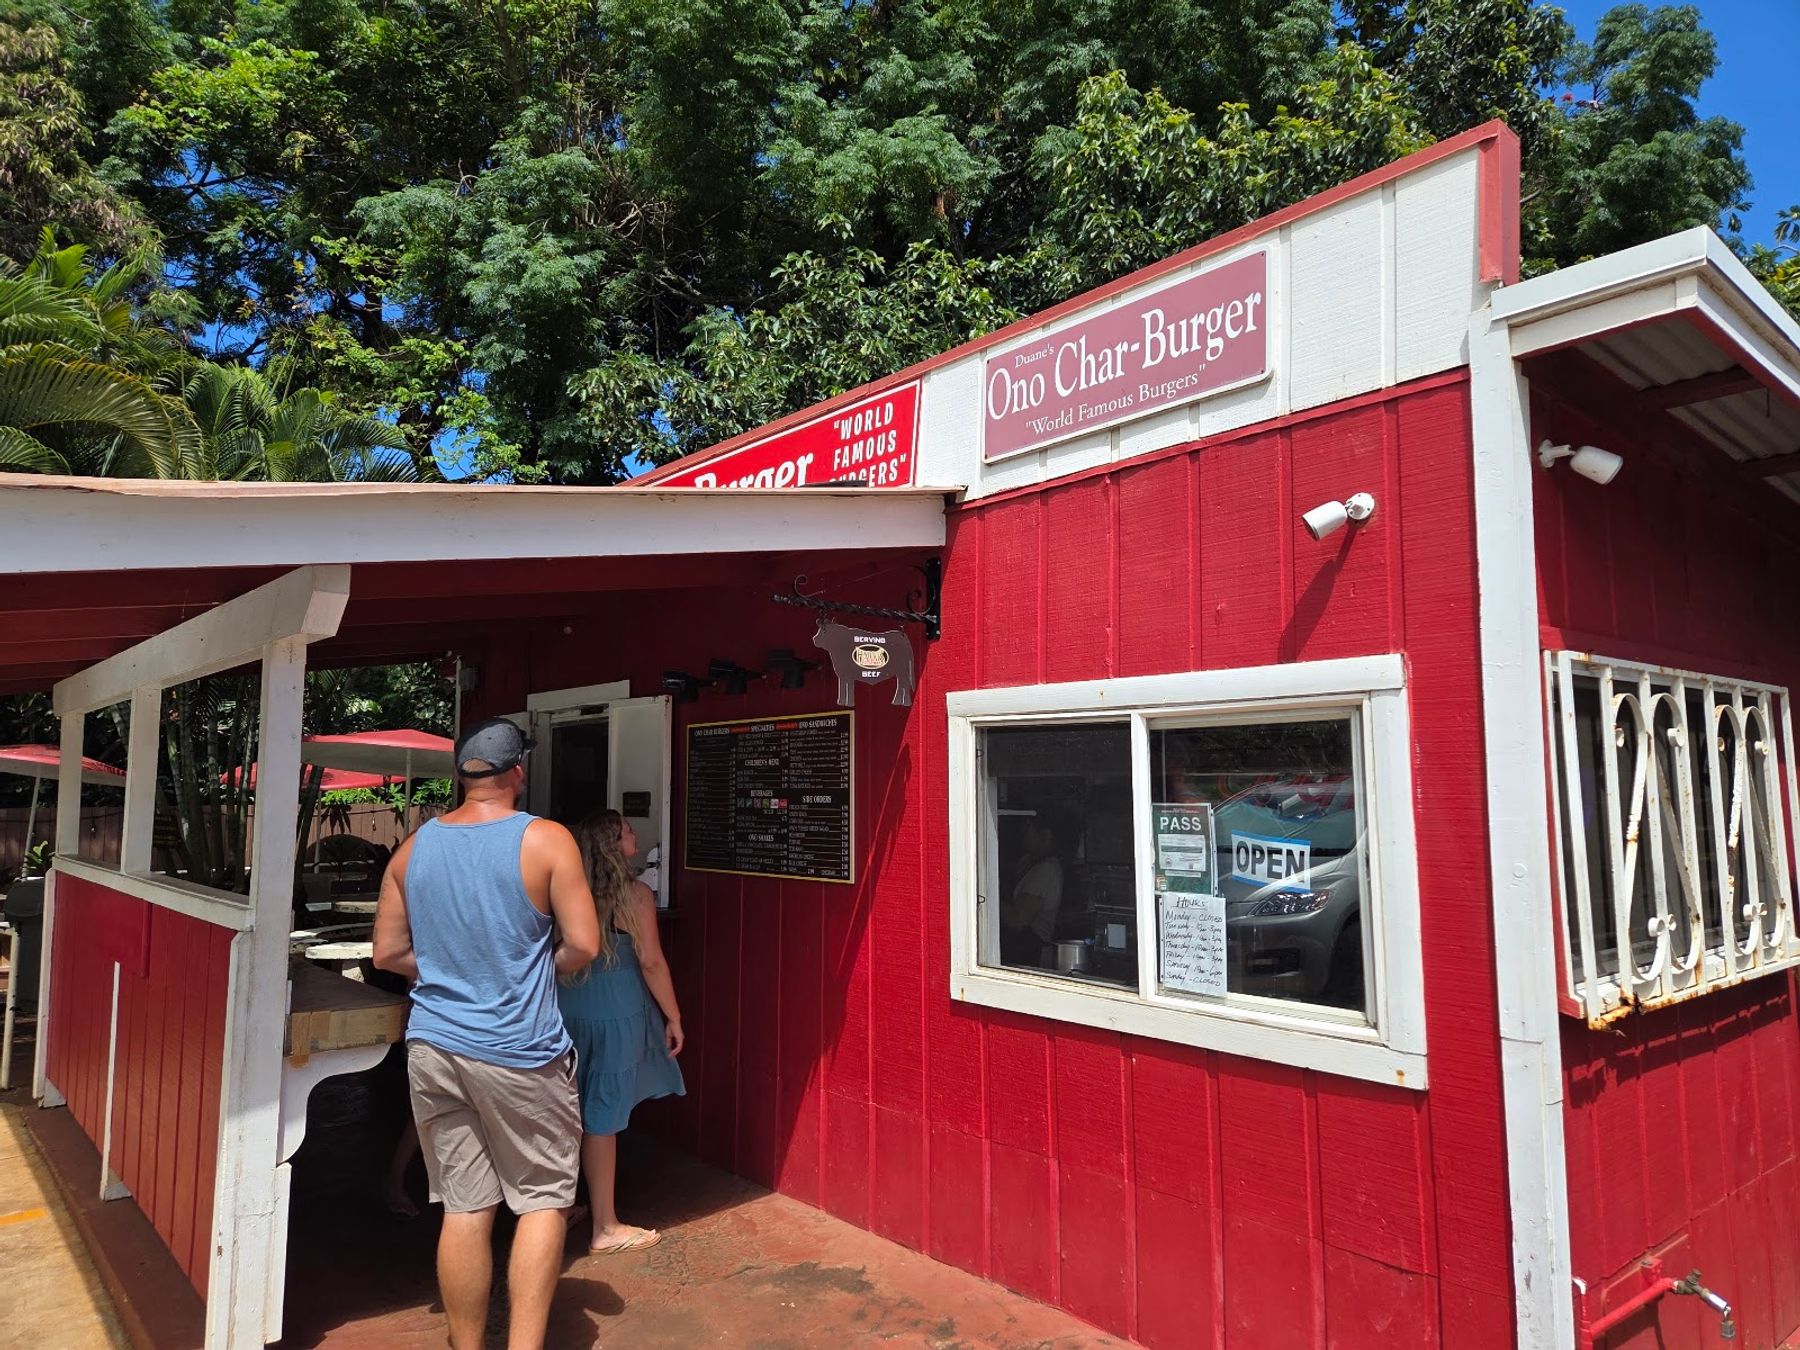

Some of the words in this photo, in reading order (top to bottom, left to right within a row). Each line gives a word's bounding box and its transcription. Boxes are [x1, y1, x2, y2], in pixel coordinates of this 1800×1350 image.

[988, 367, 1045, 420] Ono
[1054, 292, 1262, 398] Char-Burger
[1015, 344, 1054, 368] Duane's
[1026, 408, 1073, 436] "World
[1078, 393, 1133, 422] Famous
[1139, 364, 1206, 402] Burgers"
[834, 402, 894, 440] "WORLD
[834, 430, 896, 472] FAMOUS
[854, 636, 886, 644] SERVING
[1160, 816, 1202, 831] PASS
[1236, 840, 1304, 883] OPEN
